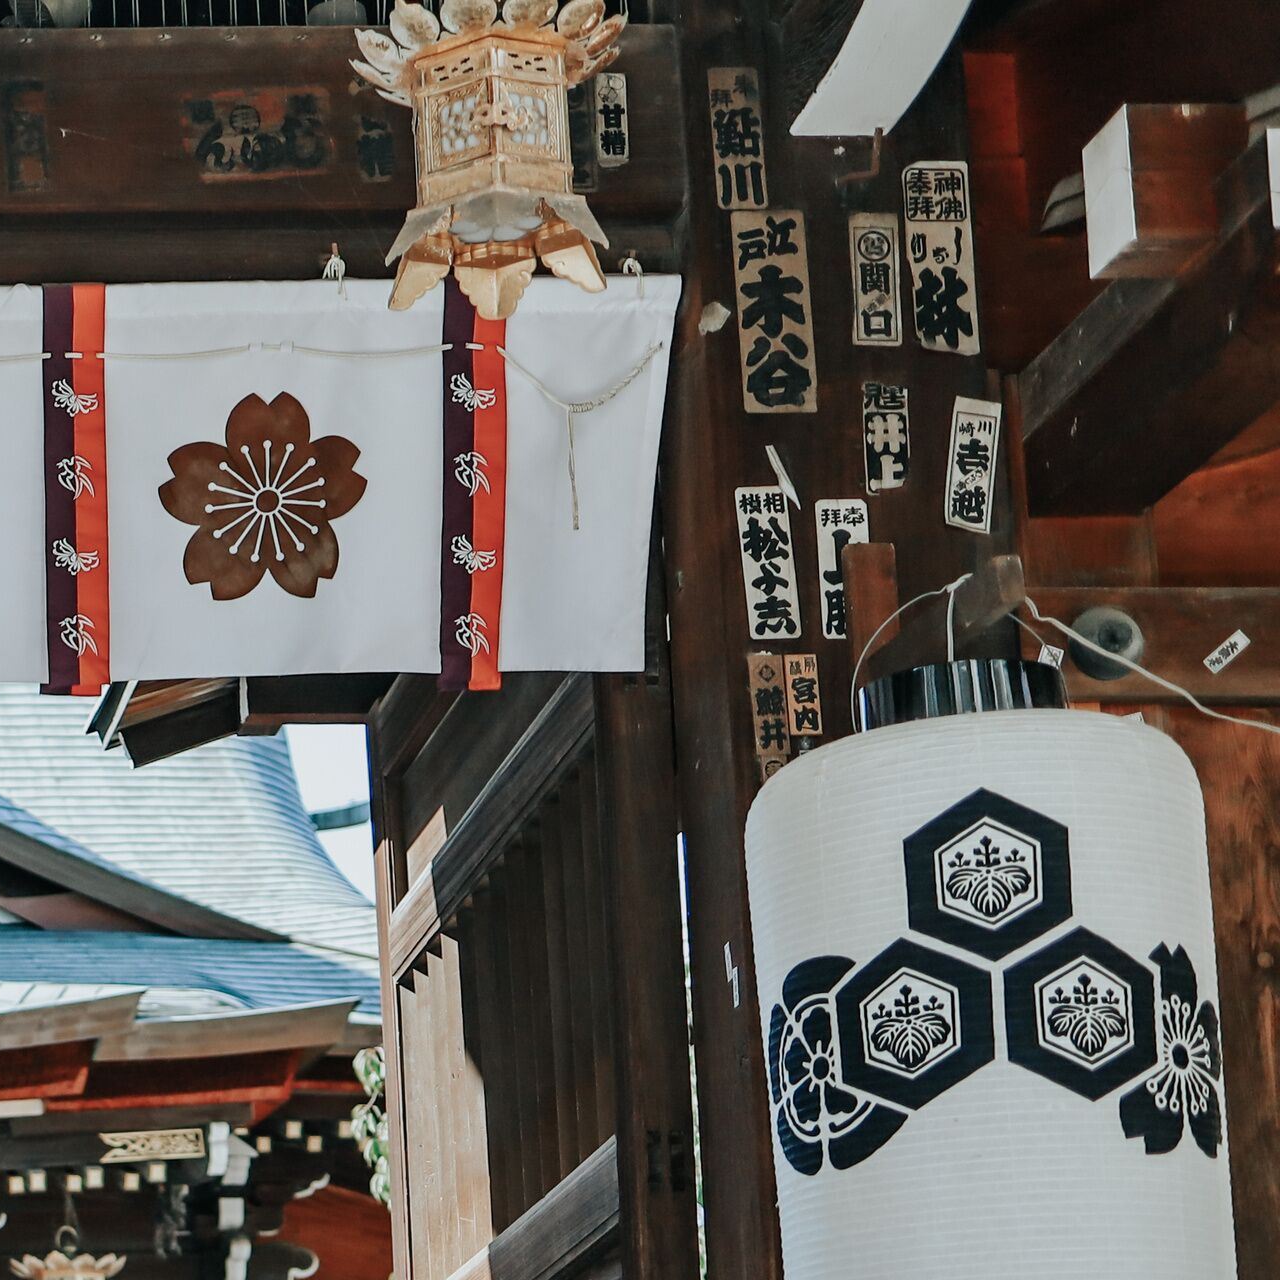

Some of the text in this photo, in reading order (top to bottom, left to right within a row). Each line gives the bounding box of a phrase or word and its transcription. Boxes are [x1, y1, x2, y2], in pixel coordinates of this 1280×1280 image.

[740, 264, 812, 406] 木谷
[859, 262, 893, 337] 関口
[866, 414, 906, 490] 井上
[791, 677, 819, 732] 宮内
